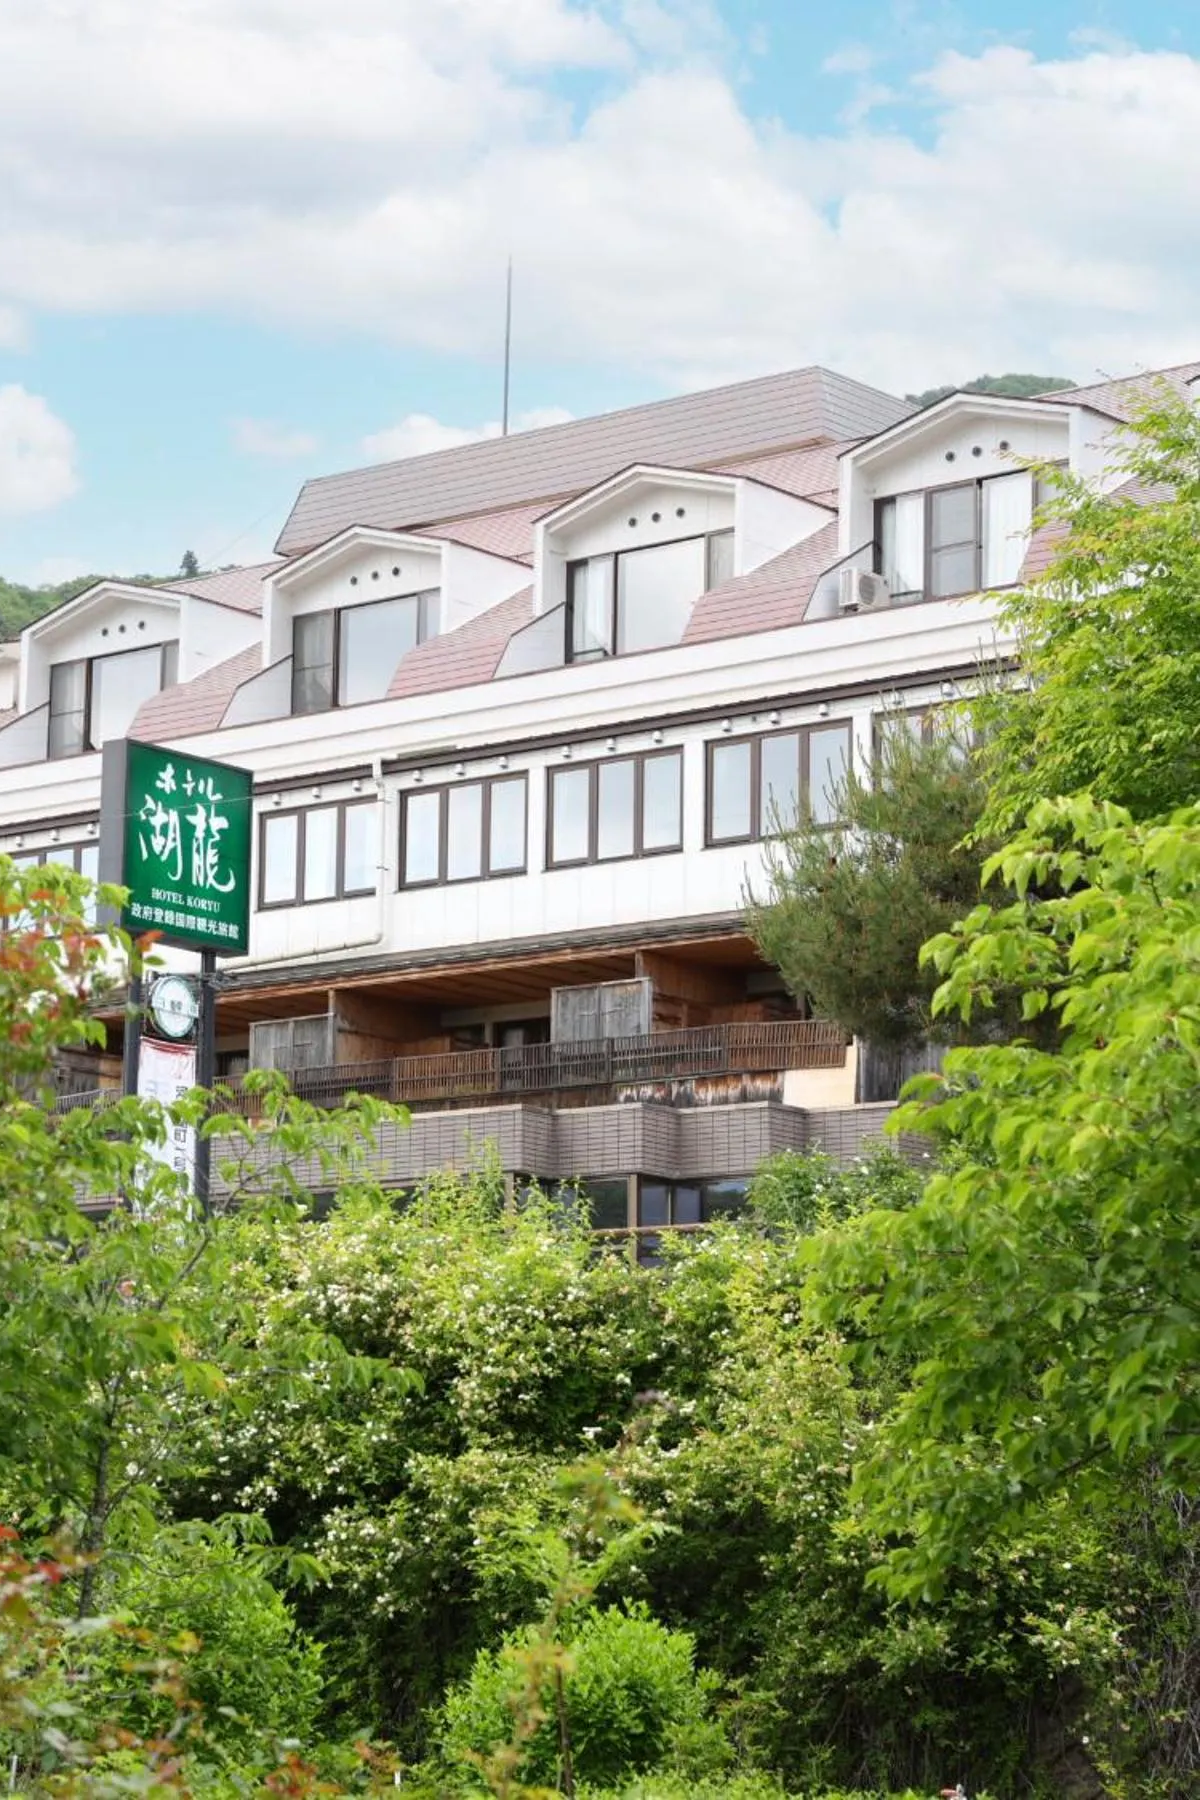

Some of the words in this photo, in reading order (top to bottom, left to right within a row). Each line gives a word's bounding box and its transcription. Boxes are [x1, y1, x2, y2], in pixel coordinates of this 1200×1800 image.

[155, 763, 222, 800] ホテル
[151, 887, 185, 905] HOTEL
[186, 895, 221, 913] KORYU
